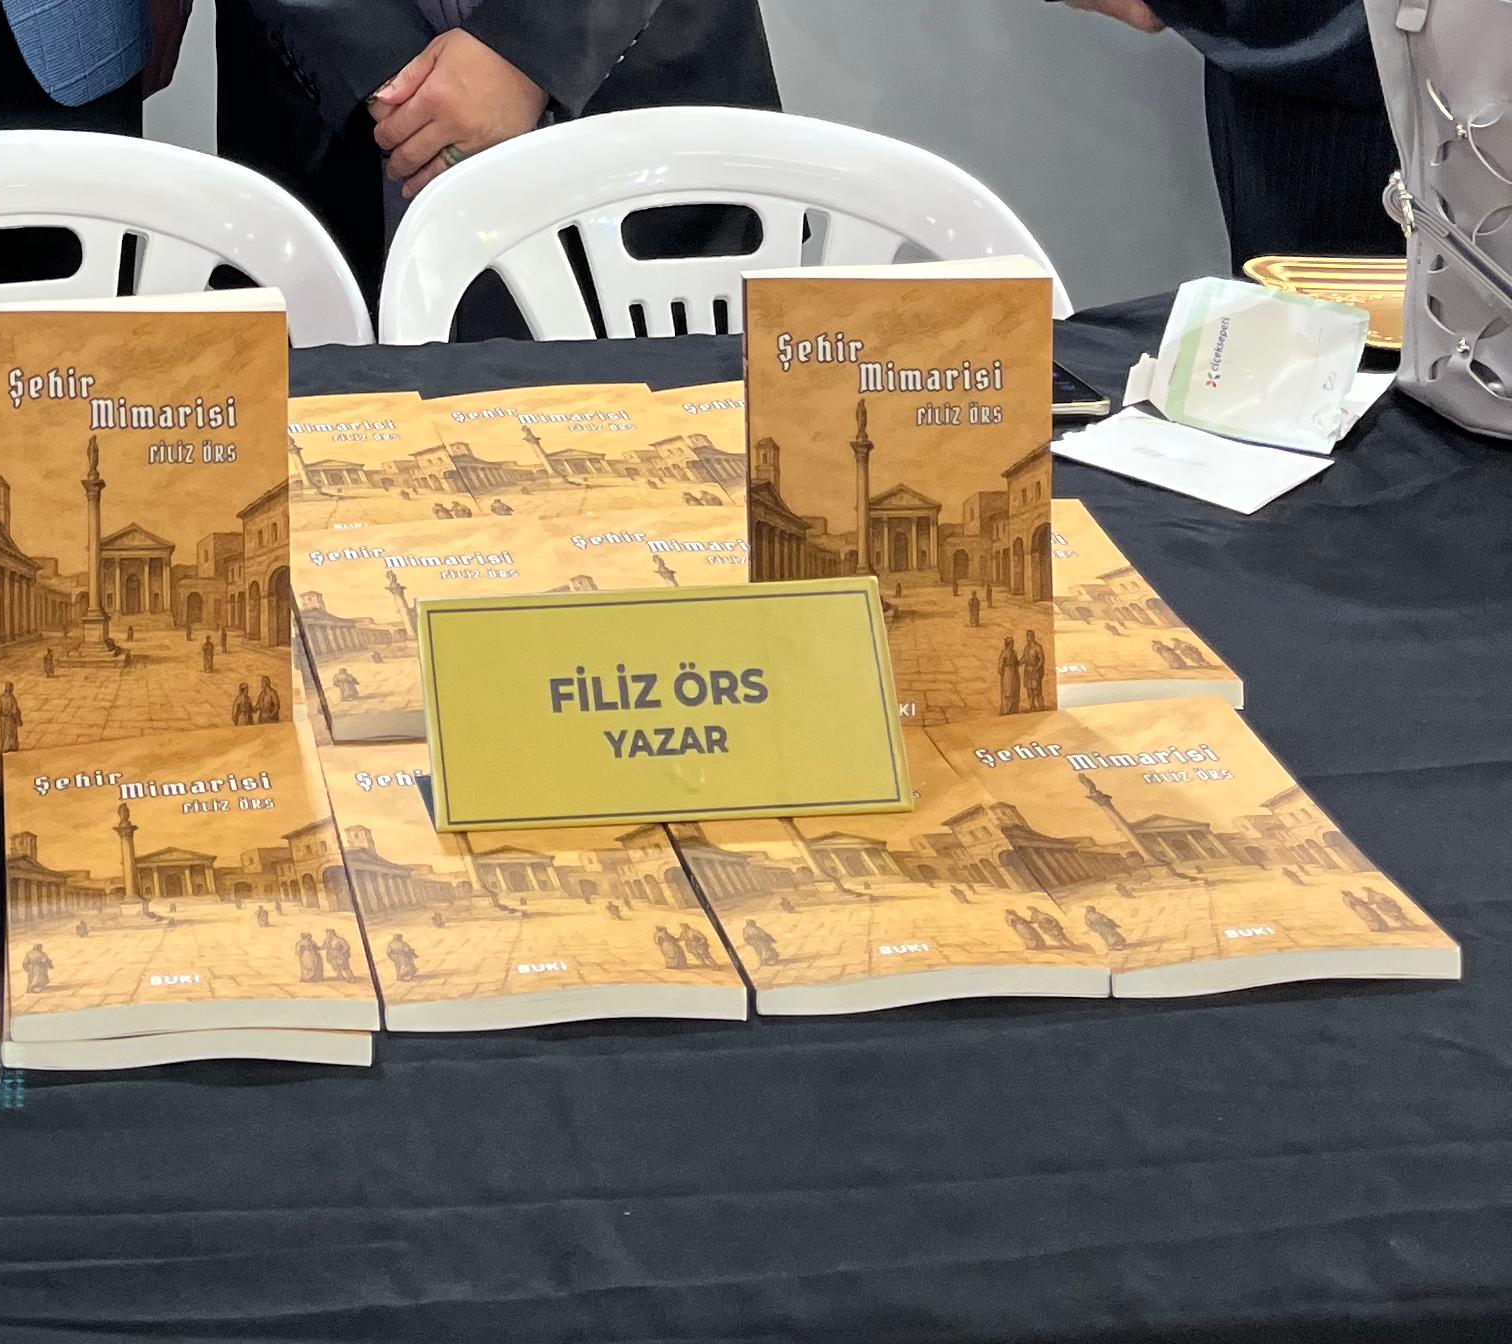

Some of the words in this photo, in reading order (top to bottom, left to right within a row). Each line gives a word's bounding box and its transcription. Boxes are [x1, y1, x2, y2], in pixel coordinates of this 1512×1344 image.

[776, 332, 865, 372] Şehir
[7, 367, 96, 409] Şehir
[858, 360, 1004, 394] Mimarisi
[89, 396, 238, 431] Mimarisi
[449, 405, 519, 424] Şehir
[517, 408, 630, 426] Mimarisi
[916, 403, 962, 427] FİLİZ
[968, 401, 1003, 425] ÖRS
[148, 439, 194, 465] FİLİZ
[201, 440, 237, 464] ÖRS
[569, 529, 647, 550] Şehir
[647, 538, 750, 554] Mimari
[308, 544, 387, 566] Şehir
[384, 550, 514, 570] Mimarisi
[1056, 664, 1087, 674] UKI
[550, 663, 662, 713] FİLİZ
[673, 662, 769, 706] ÖRS
[603, 725, 729, 759] YAZAR
[973, 740, 1064, 769] Şehir
[1065, 743, 1220, 772] Mimarisi
[33, 769, 124, 796] Şehir
[119, 770, 273, 802] Mimarisi
[354, 769, 424, 791] Şehi
[1194, 768, 1234, 782] ÖRS
[238, 797, 275, 811] ÖRS
